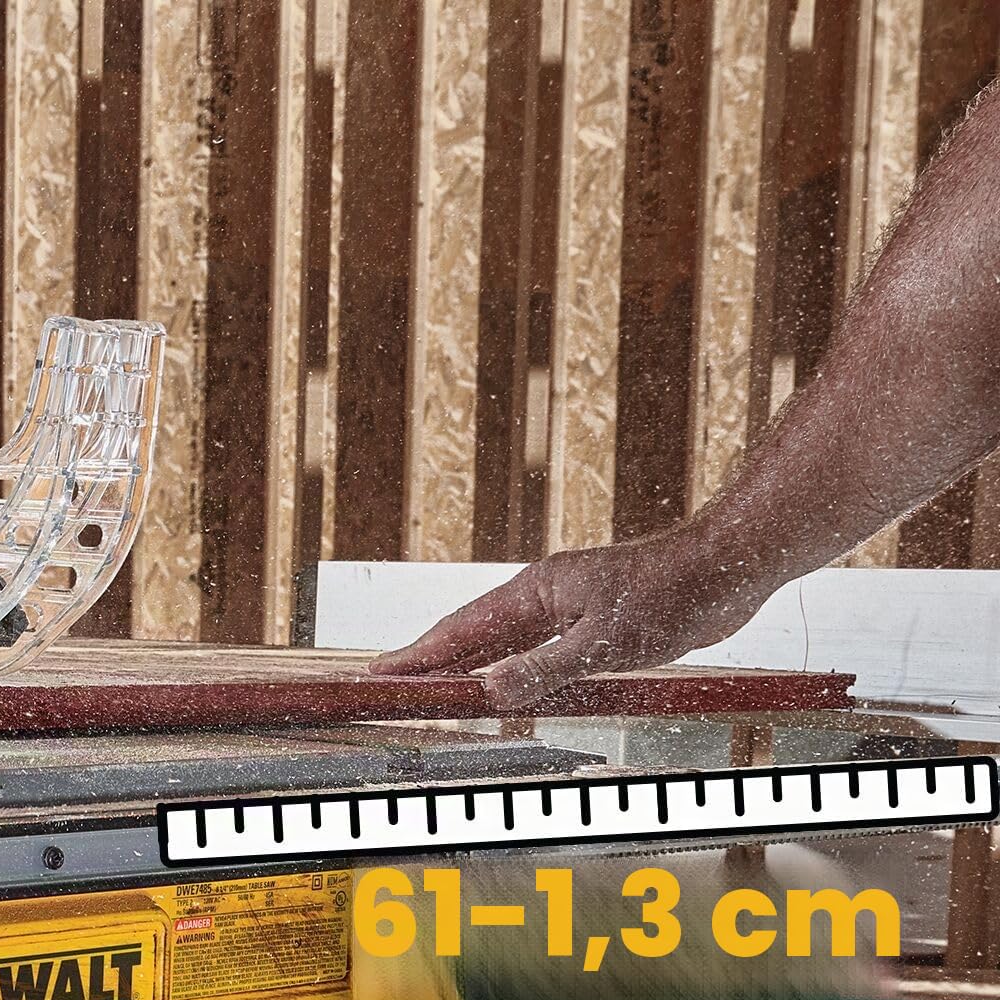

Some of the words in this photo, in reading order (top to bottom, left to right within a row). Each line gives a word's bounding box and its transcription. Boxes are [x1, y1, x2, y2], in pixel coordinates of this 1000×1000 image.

[176, 883, 212, 896] DWE7485
[248, 881, 263, 889] TABLE
[264, 880, 276, 888] SAW
[183, 918, 211, 929] DANGER
[182, 931, 215, 944] WARNING
